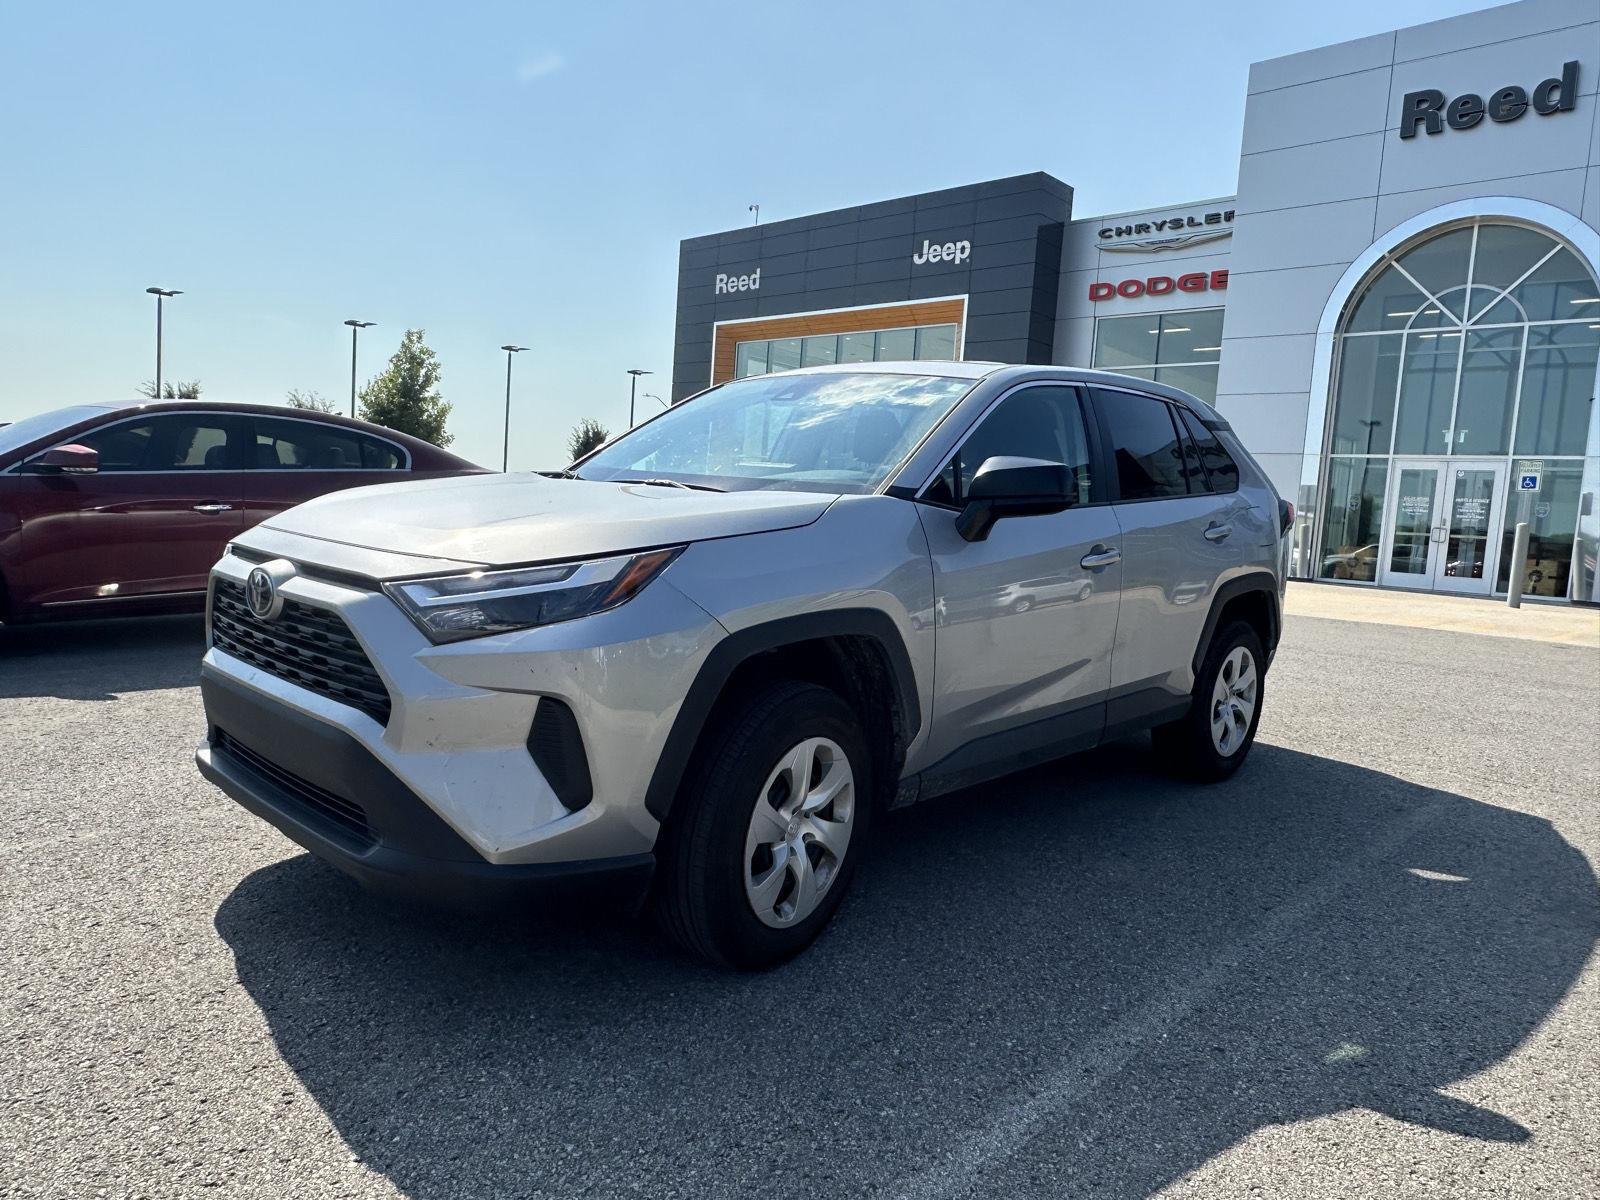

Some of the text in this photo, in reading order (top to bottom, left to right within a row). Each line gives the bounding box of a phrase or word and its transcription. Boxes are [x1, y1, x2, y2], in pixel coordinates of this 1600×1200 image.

[1400, 60, 1580, 139] Reed
[913, 239, 971, 265] Jeep
[715, 268, 761, 294] Reed
[1089, 269, 1230, 301] DODGE
